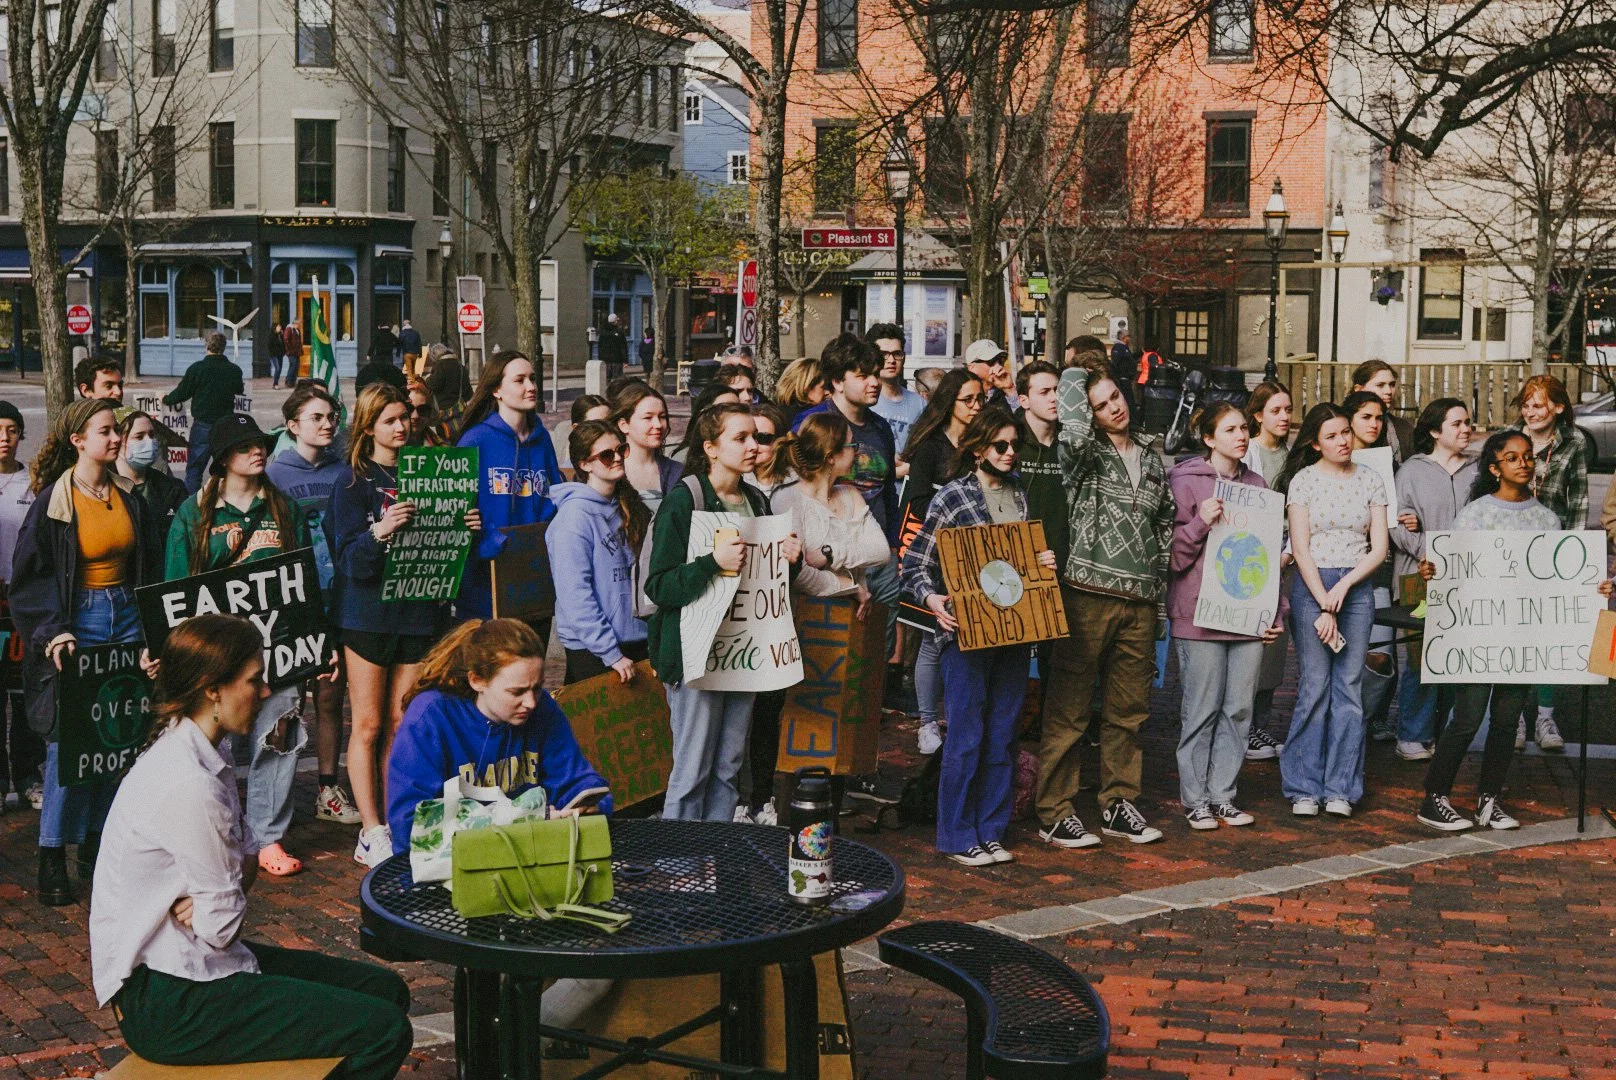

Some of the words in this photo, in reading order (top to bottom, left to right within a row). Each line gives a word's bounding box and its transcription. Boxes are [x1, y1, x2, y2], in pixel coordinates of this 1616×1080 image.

[828, 233, 872, 244] Pleasant
[877, 232, 889, 244] St
[743, 275, 757, 293] STO
[136, 397, 161, 412] TIME
[402, 455, 427, 474] IF
[434, 453, 470, 476] YOUR
[412, 514, 456, 528] INCLUDE
[1218, 511, 1249, 529] NO
[393, 530, 471, 548] INDIGENOUS
[392, 551, 418, 562] LAND
[421, 550, 459, 562] RIGHTS
[980, 520, 1054, 583] RECYCLE
[1432, 534, 1482, 580] SINK
[1494, 537, 1518, 575] OUR
[393, 564, 412, 576] IT
[414, 564, 448, 575] ISN'T
[161, 563, 306, 628] EARTH
[381, 577, 456, 600] ENOUGH
[754, 581, 788, 620] OUR
[1437, 587, 1506, 630] SWIM
[1517, 597, 1543, 625] IN
[1549, 595, 1590, 625] THE
[952, 592, 1025, 648] WASTED
[1024, 585, 1069, 639] TIME
[1198, 598, 1254, 628] PLANET
[79, 649, 138, 677] PLAN
[1425, 634, 1590, 676] CONSEQUENCES
[91, 698, 150, 722] OVER
